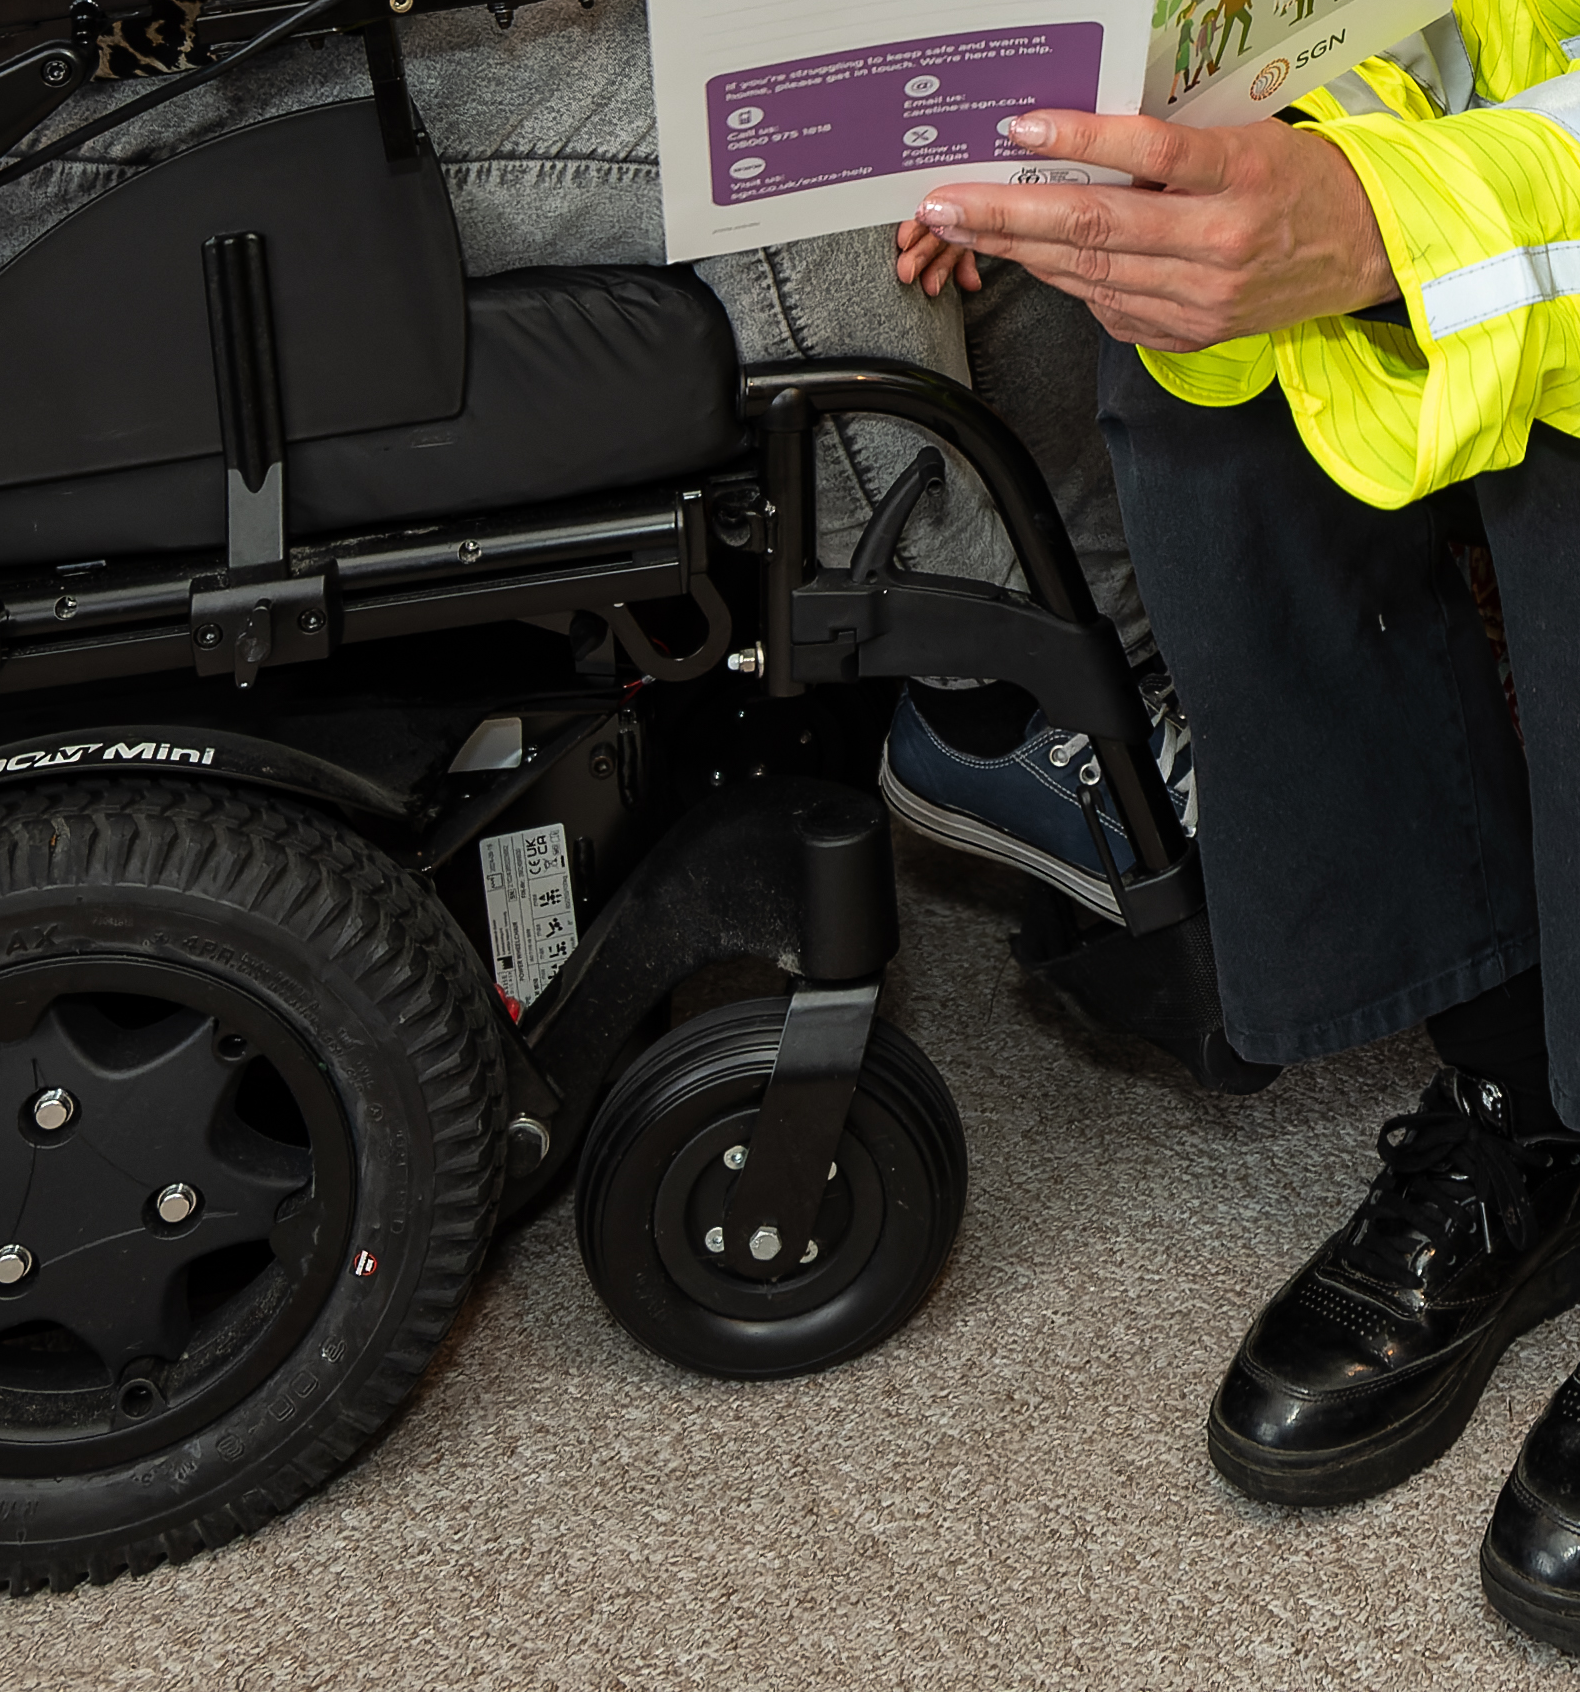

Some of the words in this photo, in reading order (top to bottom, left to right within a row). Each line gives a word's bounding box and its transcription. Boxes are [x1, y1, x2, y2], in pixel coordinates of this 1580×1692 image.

[1295, 28, 1347, 70] SGN
[740, 73, 786, 90] you're
[789, 59, 865, 80] struggling
[868, 56, 883, 66] to
[886, 49, 922, 63] keep
[925, 44, 955, 57] safe
[958, 40, 986, 52] and
[989, 37, 1028, 49] warm
[1032, 35, 1046, 45] at
[774, 77, 823, 93] please
[825, 71, 850, 84] get
[854, 67, 868, 78] in
[872, 60, 917, 75] touch.
[920, 55, 962, 67] We're
[965, 49, 996, 62] here
[1000, 47, 1016, 57] to
[1019, 44, 1053, 57] help.
[903, 95, 943, 109] Email
[945, 93, 967, 104] us:
[903, 96, 1036, 119] careline@sgn.co.uk
[726, 128, 757, 142] Call
[727, 137, 769, 151] 0800
[772, 129, 800, 143] 975
[802, 123, 833, 136] 1818
[902, 145, 949, 158] Follow
[951, 143, 968, 152] us
[902, 152, 970, 167] @SGNgas
[730, 165, 874, 201] sgn.co.uk/extra-help
[730, 177, 761, 191] Visit
[103, 742, 216, 766] Mini
